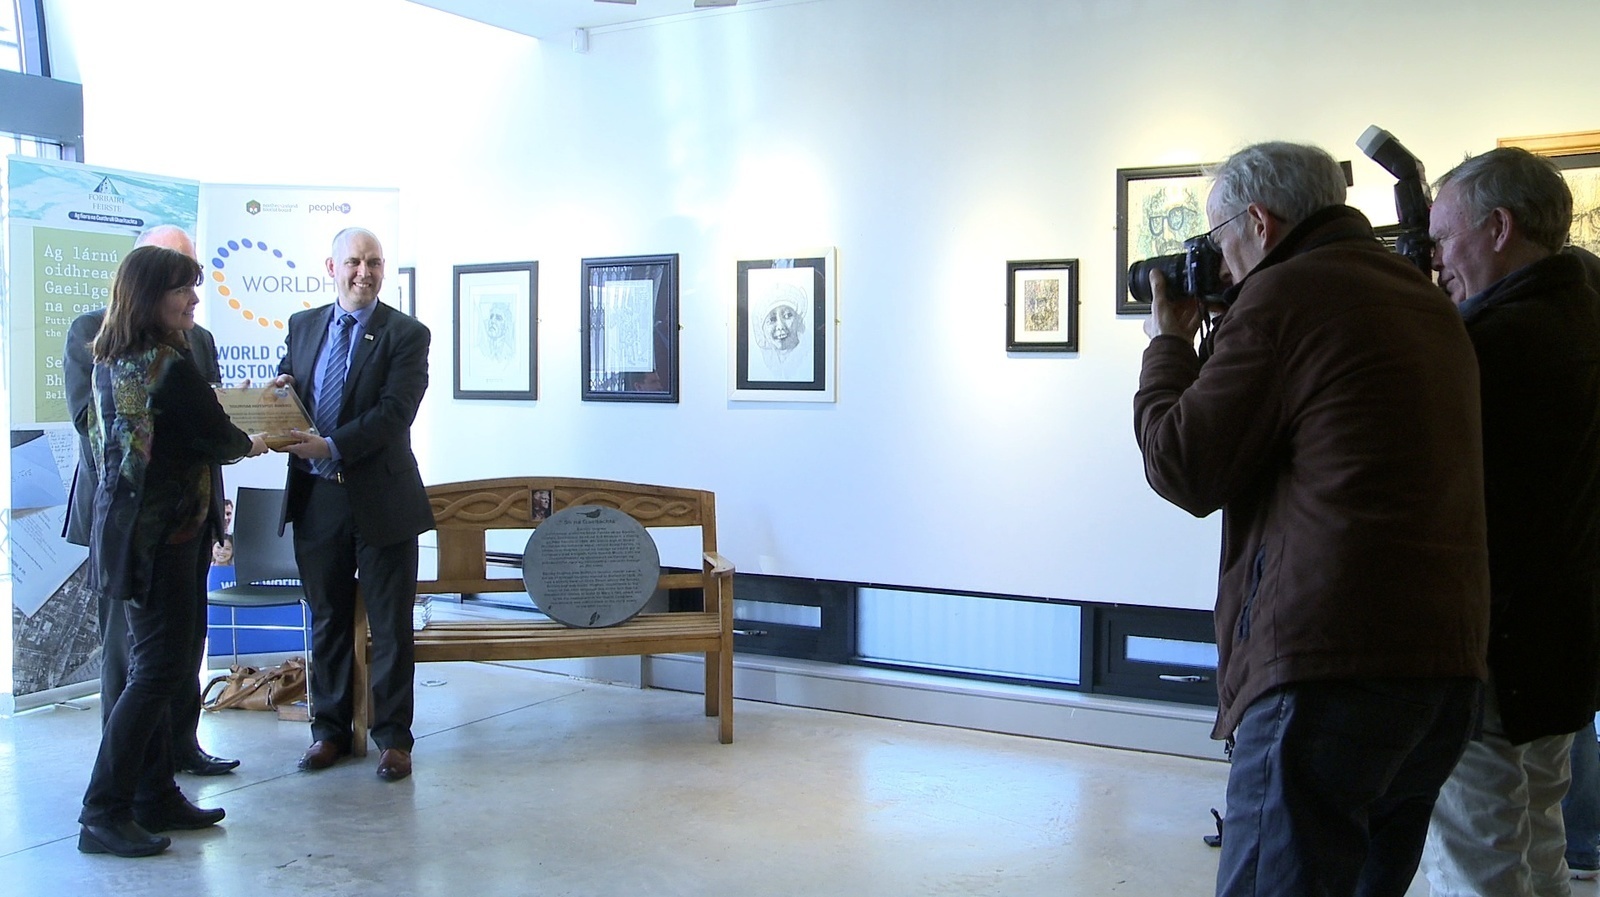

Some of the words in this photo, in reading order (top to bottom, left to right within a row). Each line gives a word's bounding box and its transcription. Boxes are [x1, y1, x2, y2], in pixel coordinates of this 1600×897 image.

[92, 203, 121, 212] FEIRSTE
[44, 244, 63, 262] Ag
[73, 246, 118, 263] lárnú
[45, 263, 116, 280] oidhreac
[44, 280, 109, 300] Gaeilge
[242, 275, 336, 293] WORLDH
[45, 301, 63, 312] na
[45, 316, 74, 325] Putti
[45, 329, 61, 337] the
[218, 345, 270, 360] WORLD
[46, 356, 62, 368] Se
[45, 374, 65, 386] Bh
